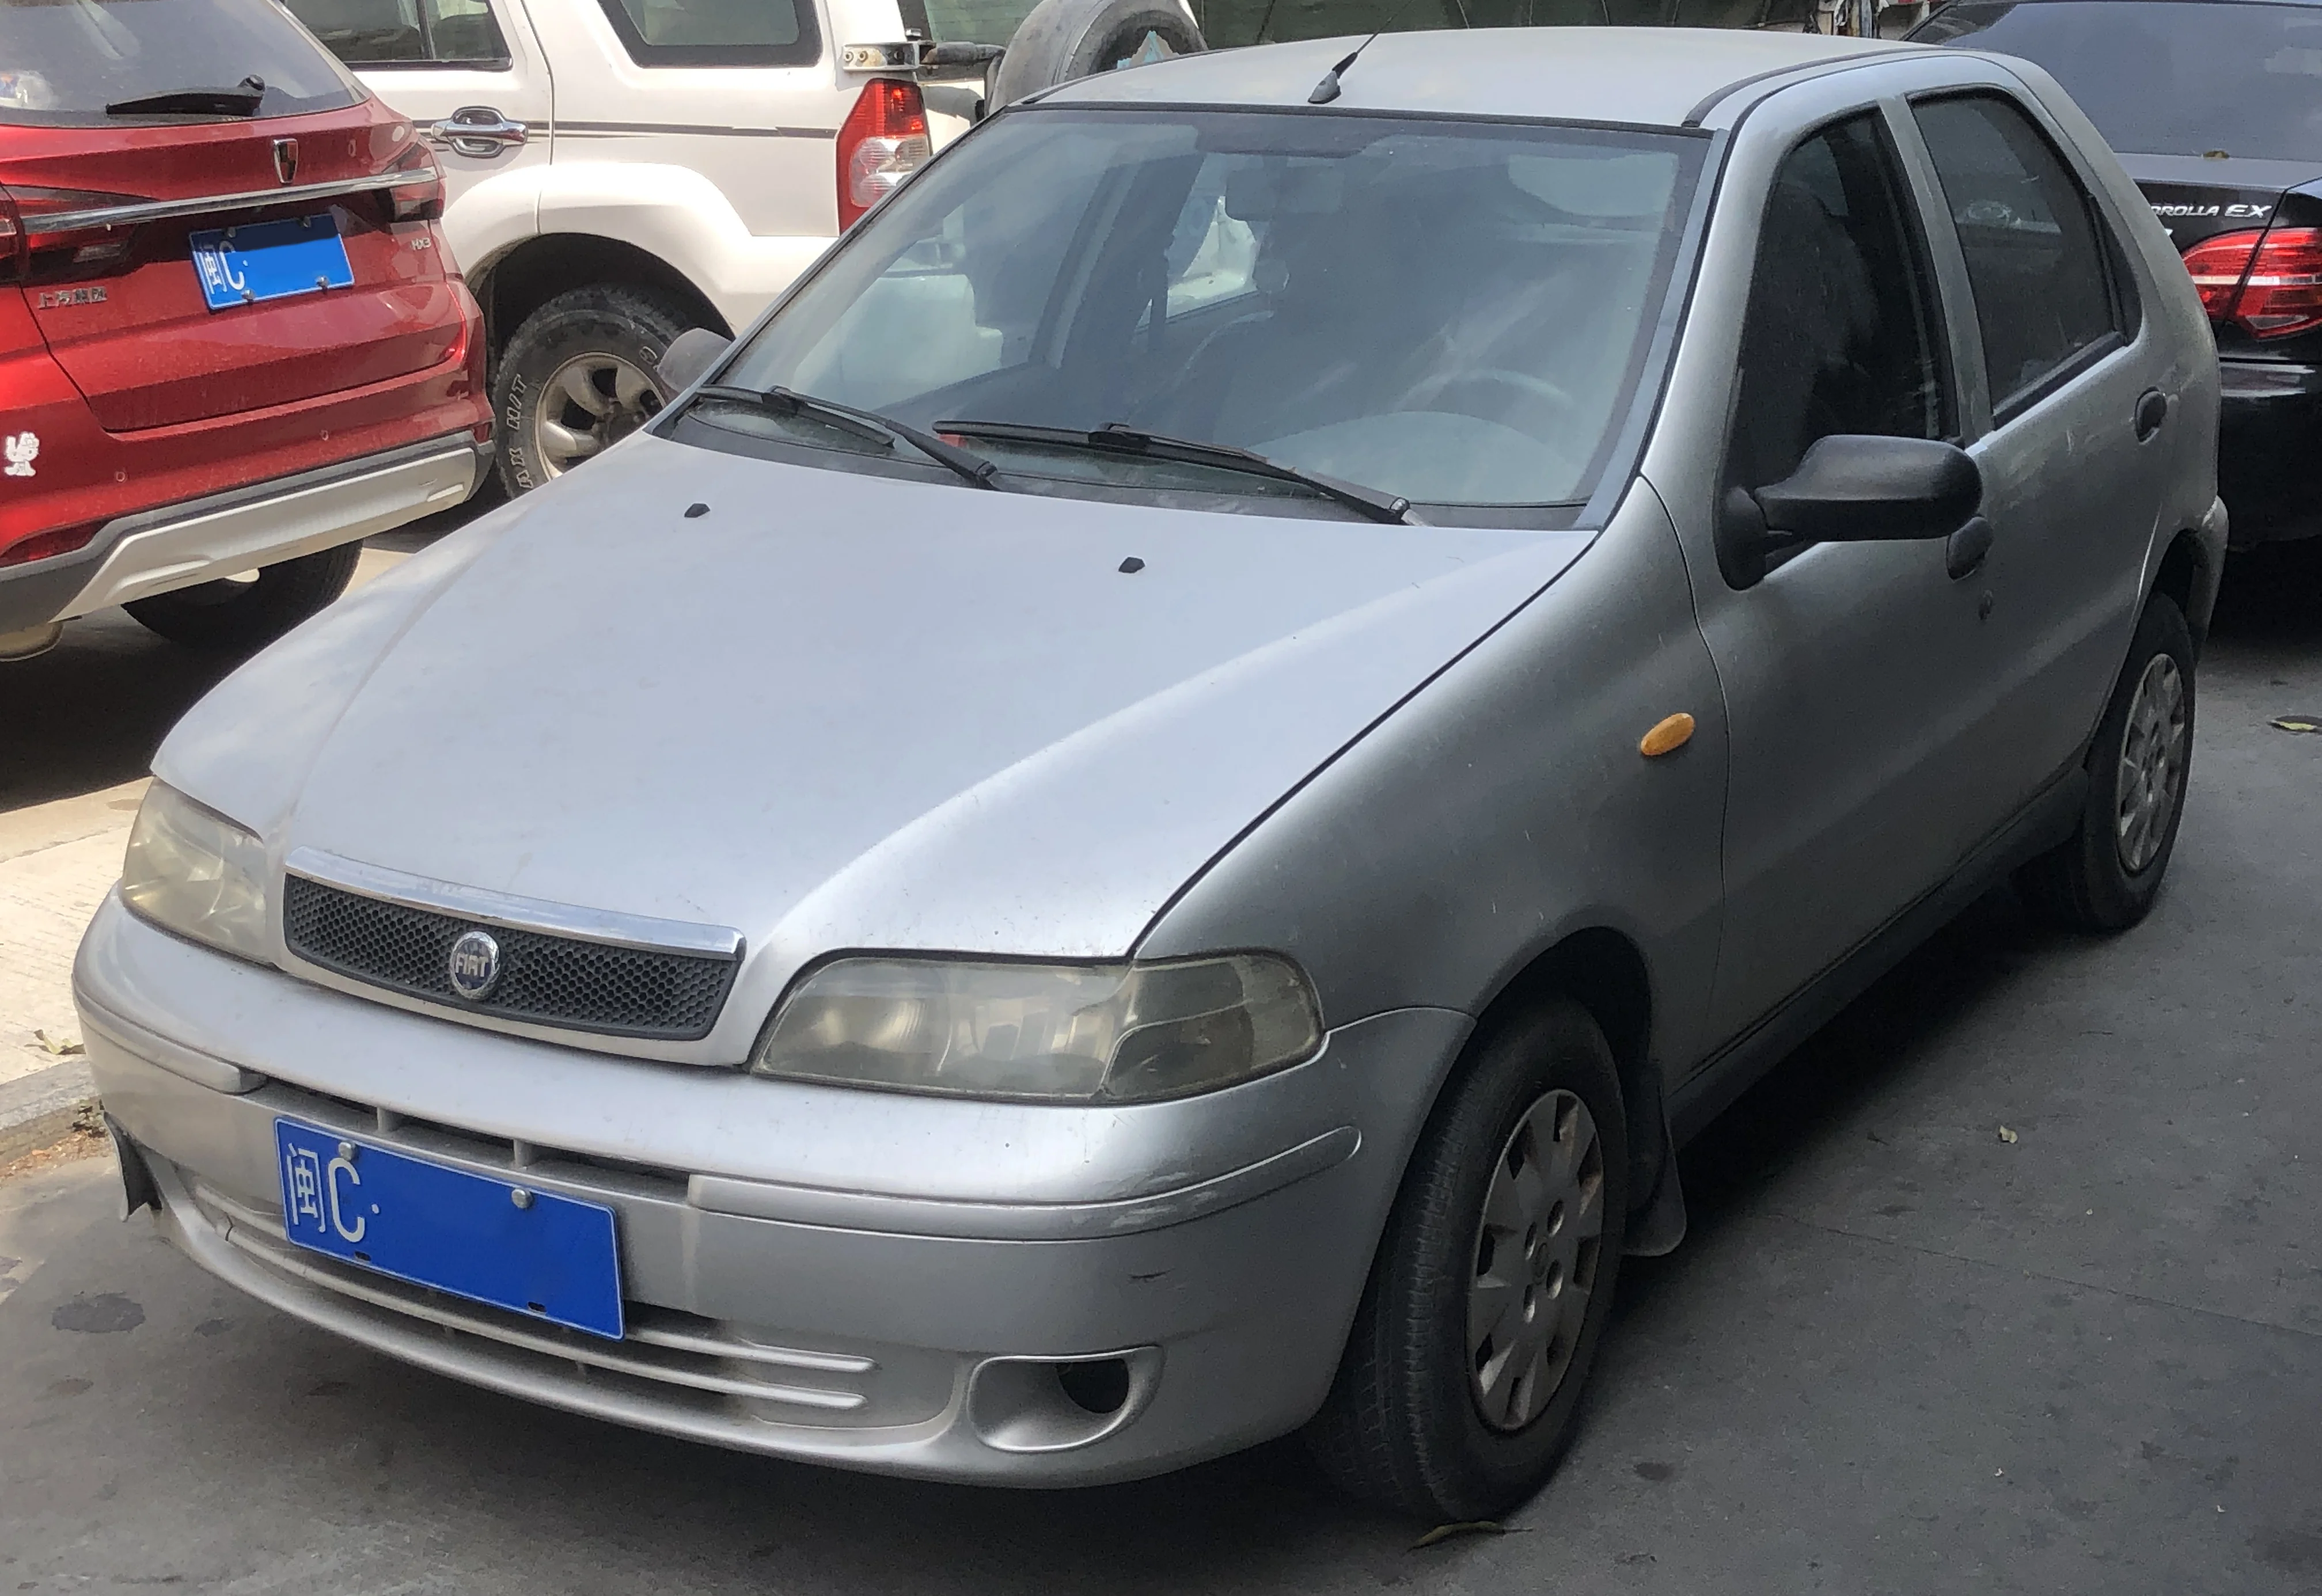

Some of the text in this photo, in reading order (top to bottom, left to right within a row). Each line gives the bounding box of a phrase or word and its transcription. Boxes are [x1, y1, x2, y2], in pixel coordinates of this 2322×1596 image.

[2150, 204, 2274, 218] OROLLA EX
[455, 952, 489, 977] FIAT
